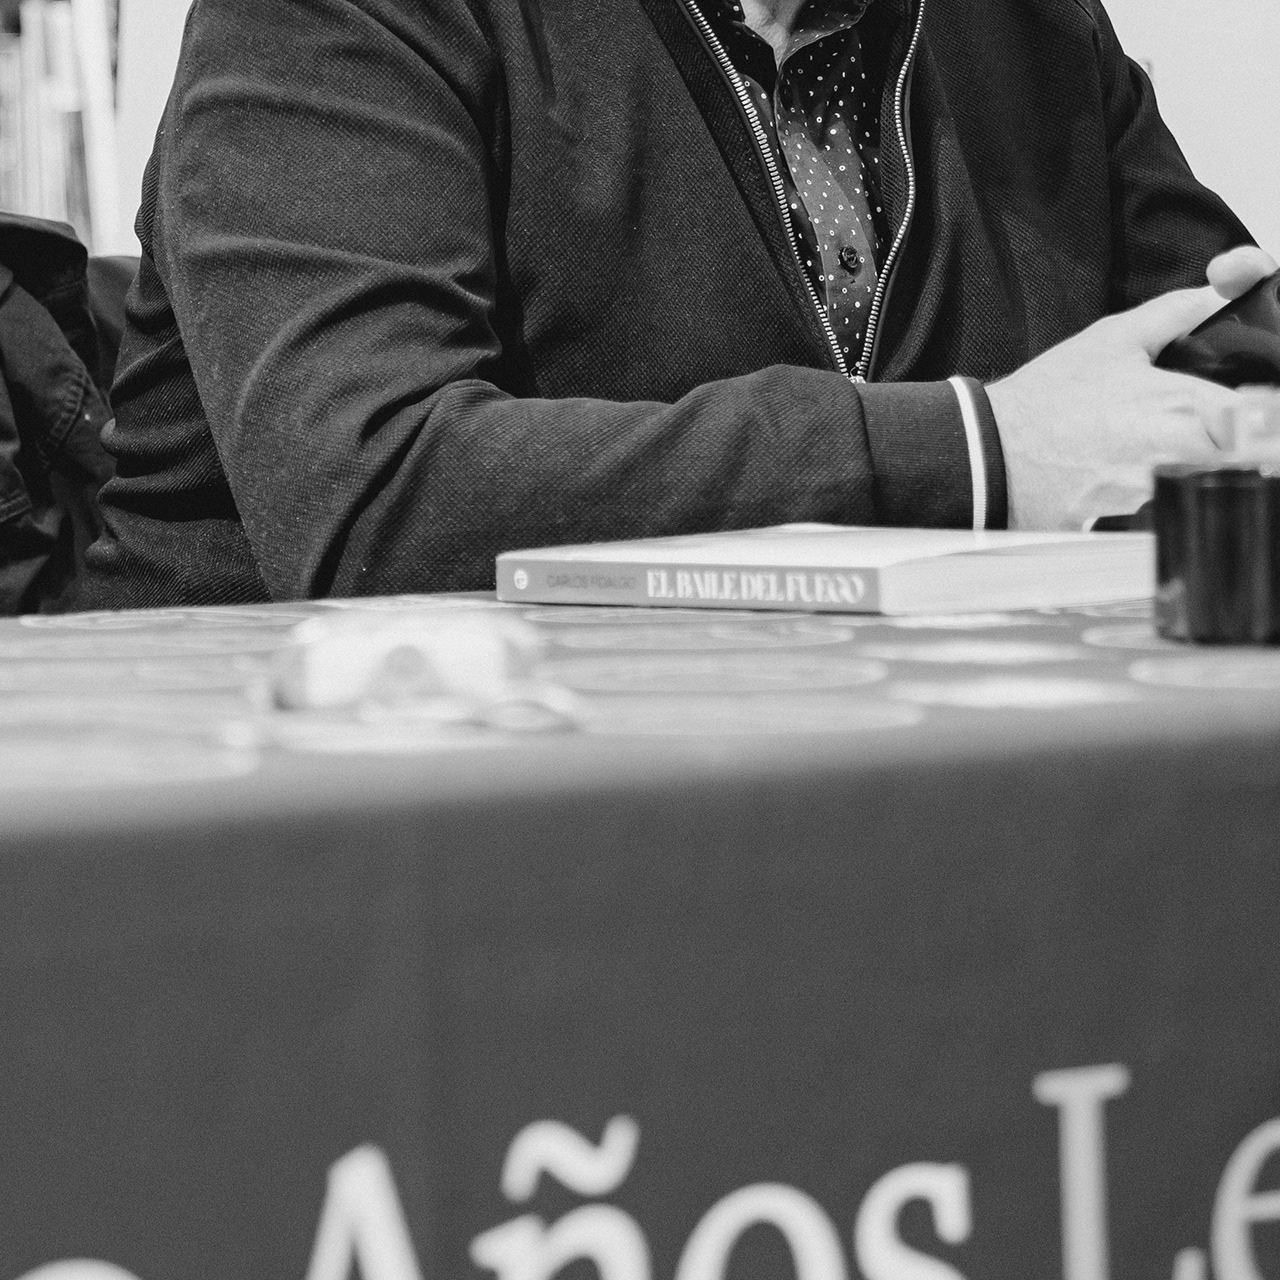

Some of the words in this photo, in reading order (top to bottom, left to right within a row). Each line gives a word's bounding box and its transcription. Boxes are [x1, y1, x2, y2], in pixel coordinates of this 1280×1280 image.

[646, 570, 674, 598] EL
[676, 570, 739, 600] BAILE
[740, 572, 784, 602] DEL
[786, 572, 865, 604] FUEGO
